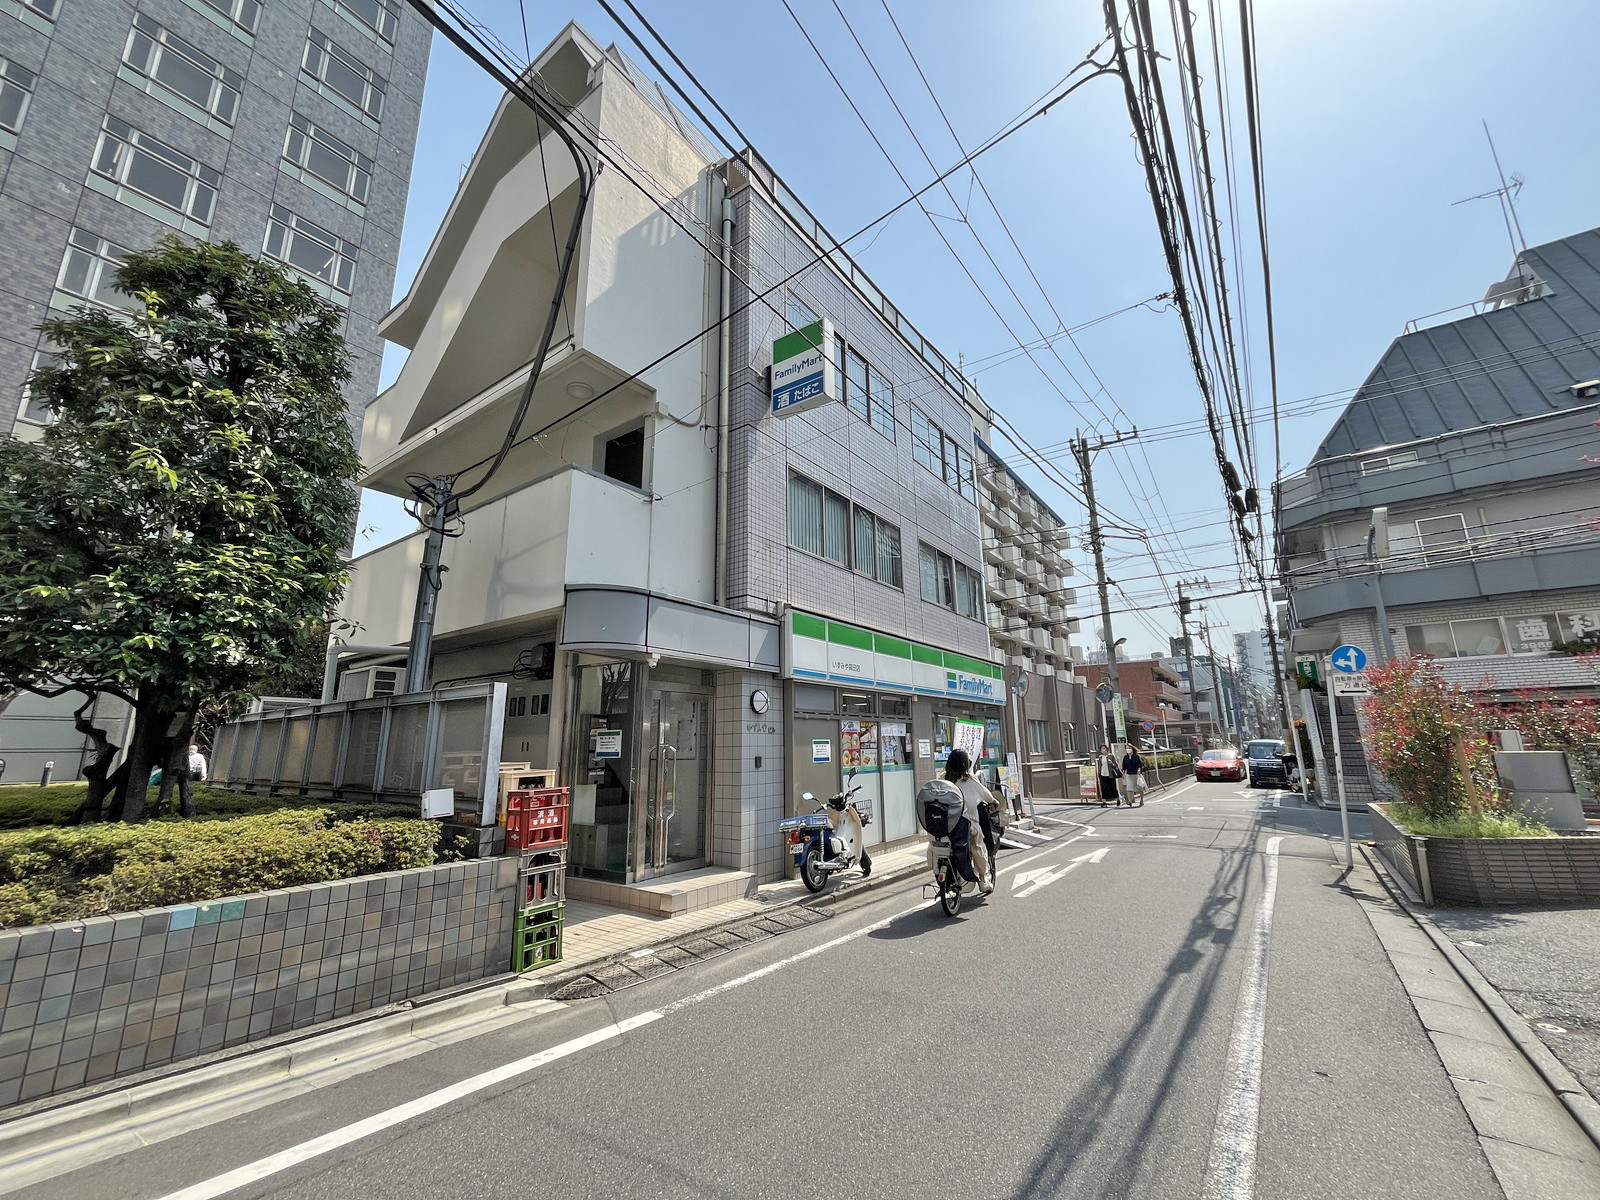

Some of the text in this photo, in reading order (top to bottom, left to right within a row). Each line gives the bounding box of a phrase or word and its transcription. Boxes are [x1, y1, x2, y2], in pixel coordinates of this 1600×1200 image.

[774, 354, 823, 380] FamilyMart
[777, 382, 820, 408] 酒 たばこ
[958, 674, 993, 696] FamilyMart
